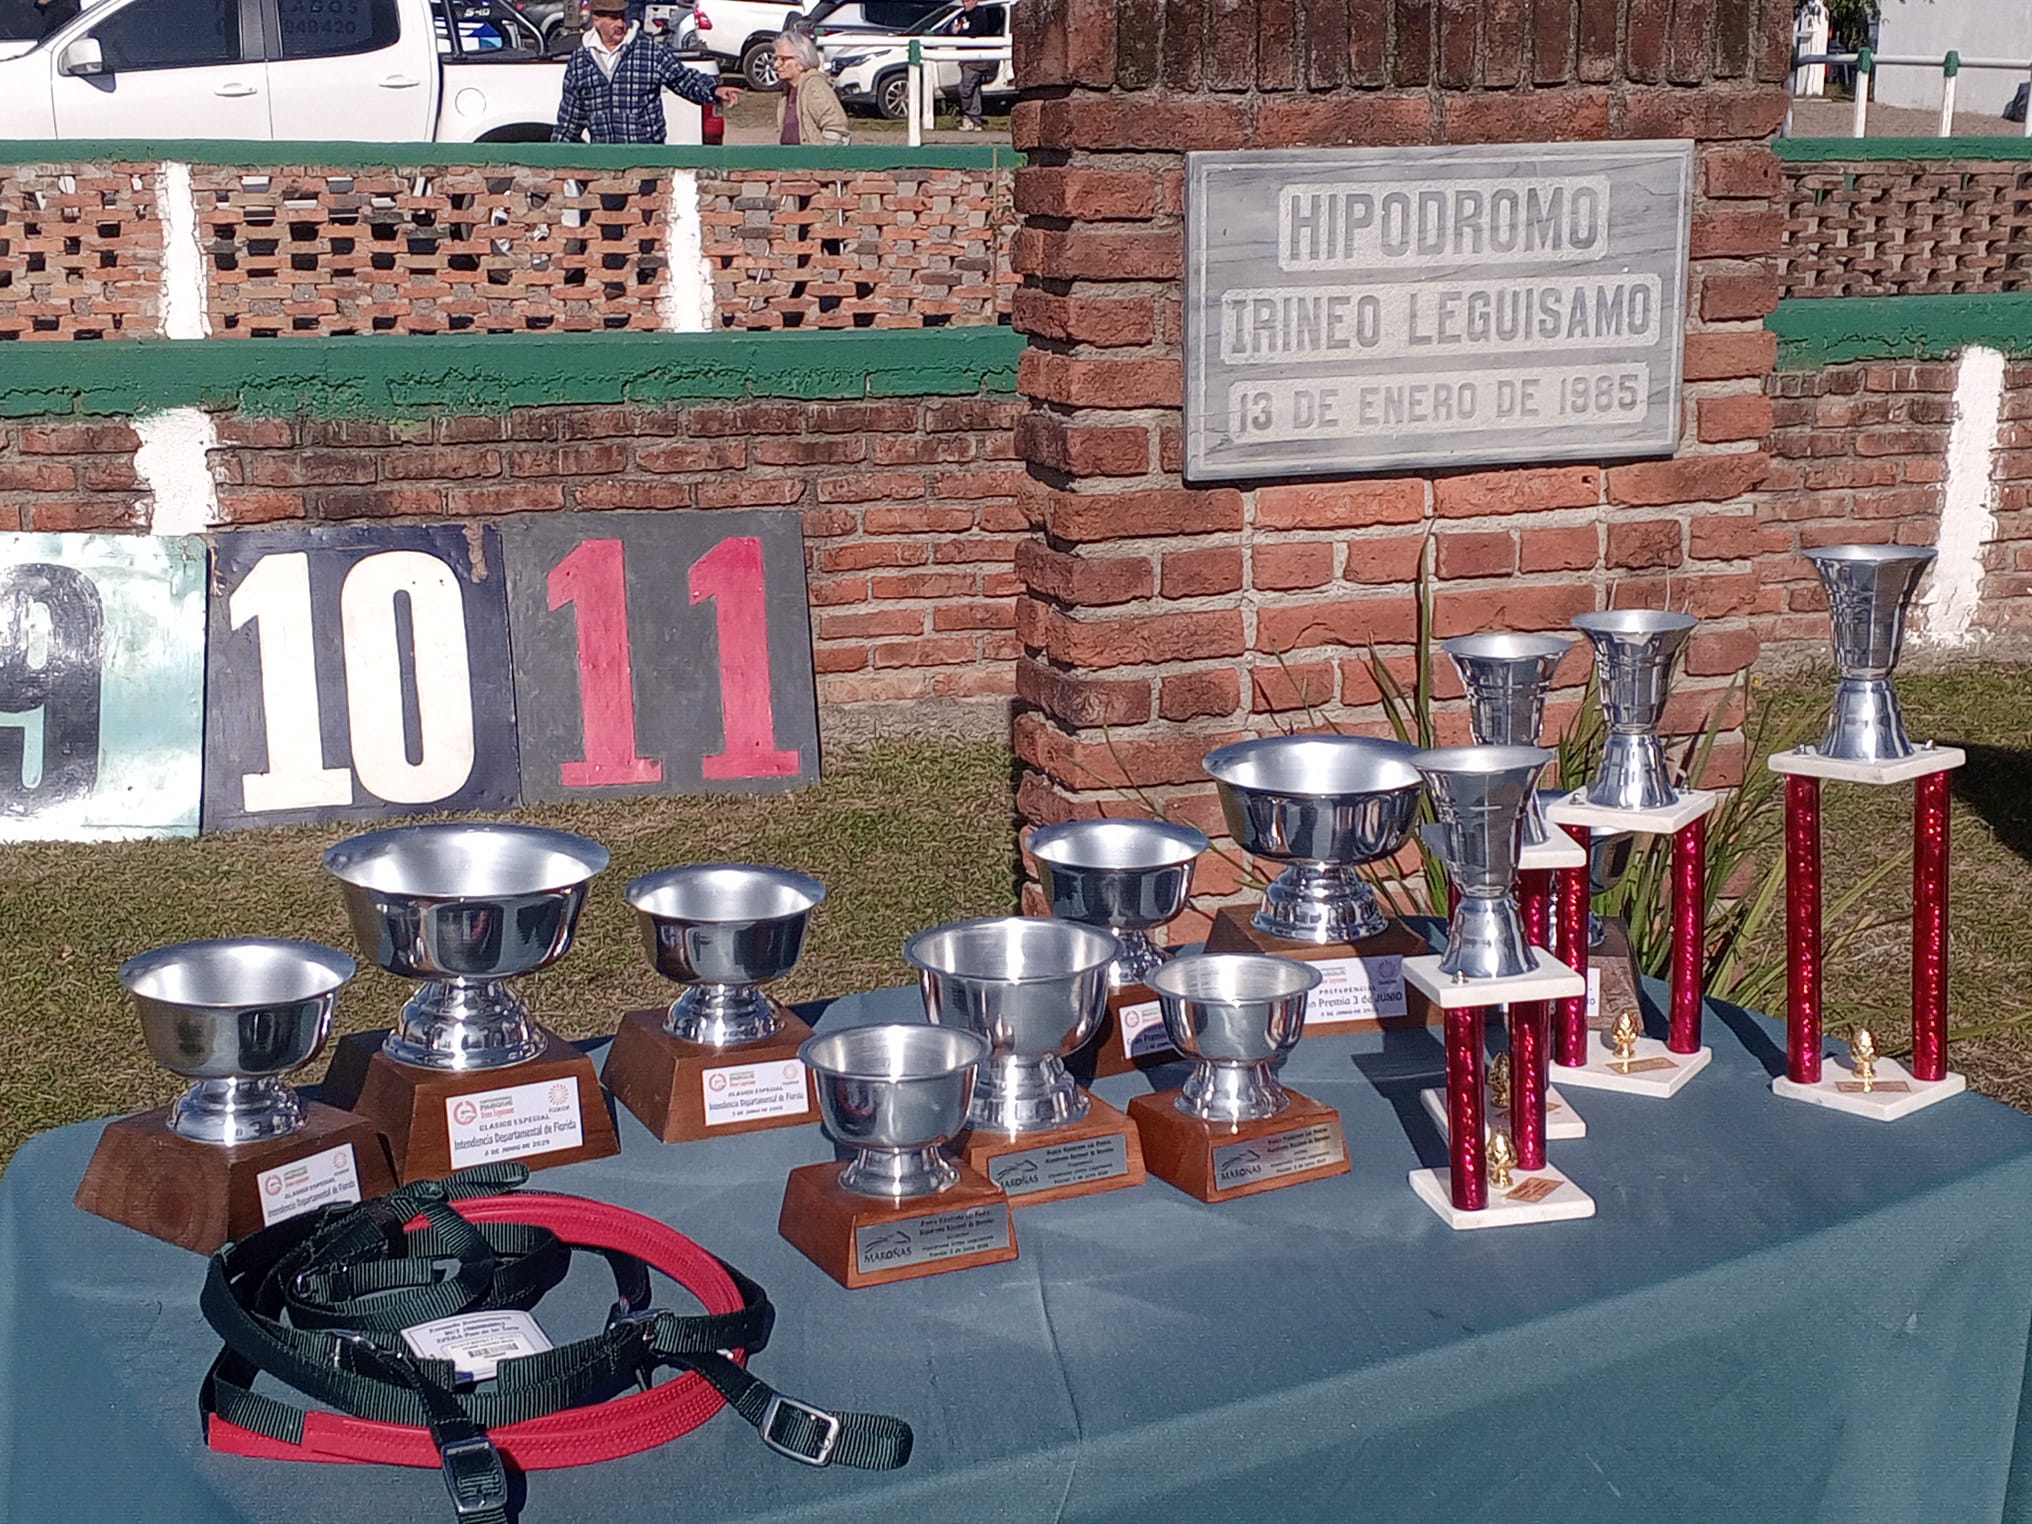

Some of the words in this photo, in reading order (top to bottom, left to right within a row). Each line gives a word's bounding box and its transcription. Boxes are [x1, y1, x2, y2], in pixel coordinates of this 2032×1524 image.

[1290, 187, 1599, 261] HIPODROMO
[1230, 294, 1382, 354] IRINEO
[1409, 283, 1652, 346] LEGUISAMO
[1239, 392, 1273, 433] 13
[1293, 389, 1339, 430] DE
[1359, 383, 1477, 426] ENERO
[1497, 379, 1541, 419] DE
[1559, 374, 1640, 415] 1985
[229, 549, 476, 813] 10
[545, 537, 800, 787] 11
[1375, 991, 1403, 1003] JUNIO
[495, 1126, 543, 1144] Departamental
[553, 1119, 577, 1134] Florida
